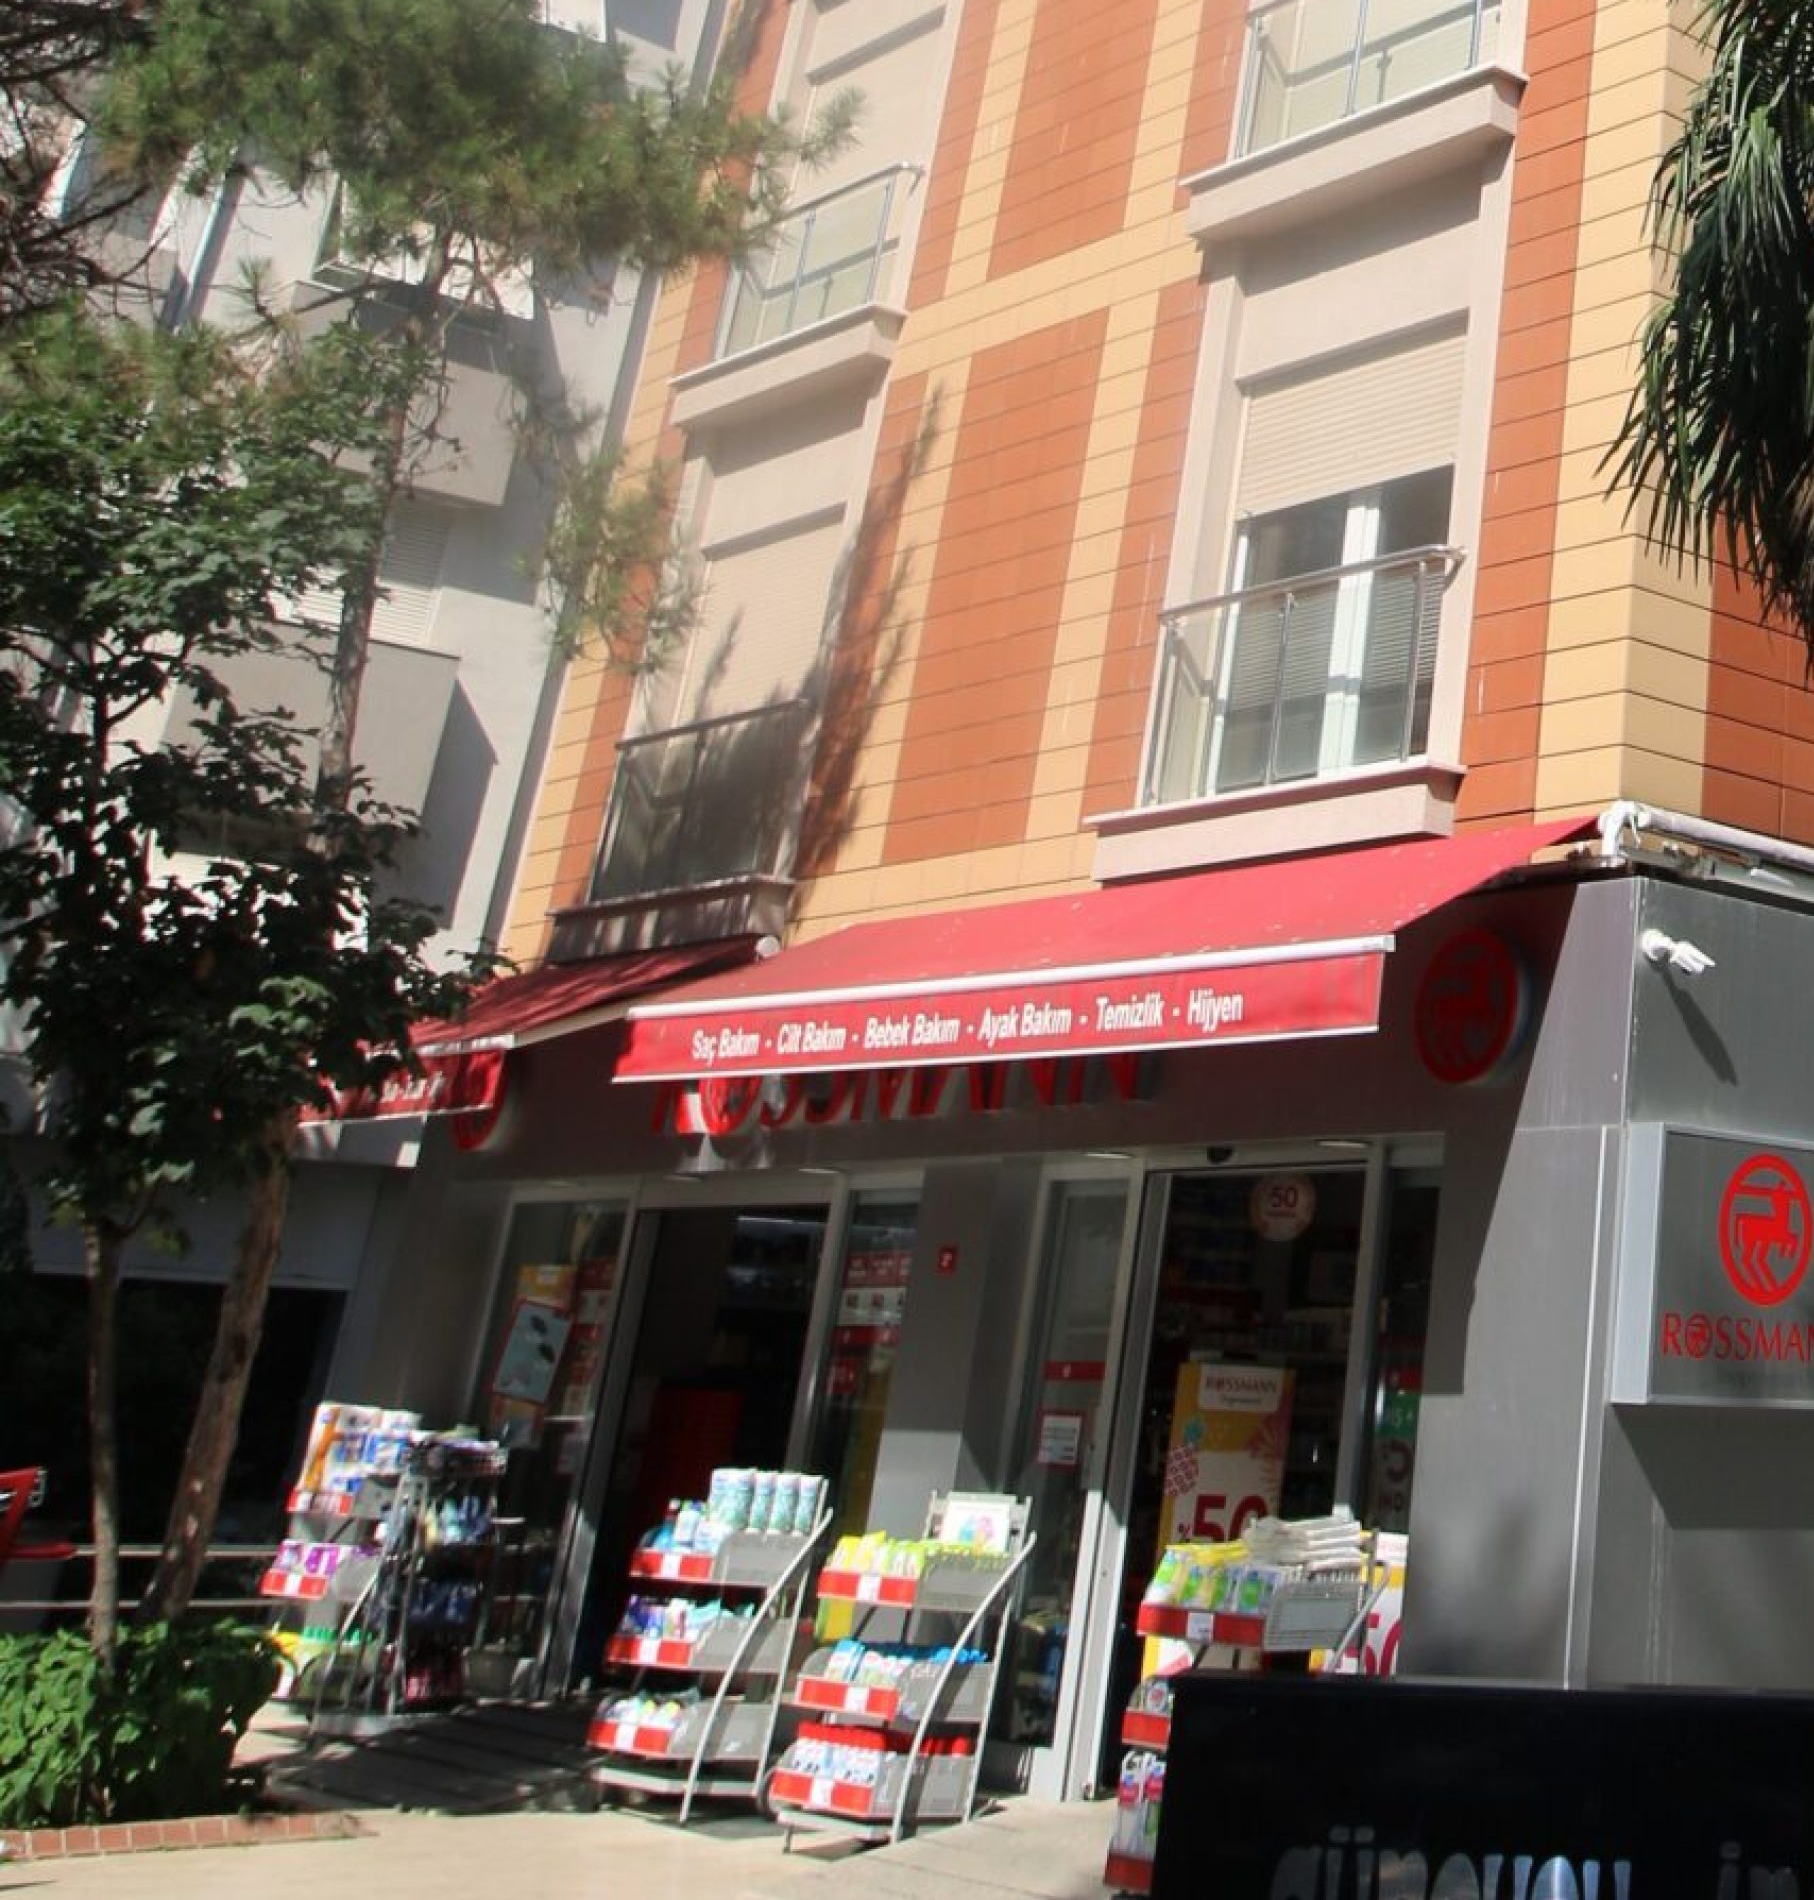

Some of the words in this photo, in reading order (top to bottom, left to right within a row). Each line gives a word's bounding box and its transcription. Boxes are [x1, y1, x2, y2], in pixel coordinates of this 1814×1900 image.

[692, 1027, 716, 1065] Saç
[718, 1026, 760, 1058] Bakım
[778, 1021, 802, 1055] Cilt
[803, 1019, 847, 1052] Bakım
[863, 1014, 910, 1049] Bebek
[911, 1012, 960, 1046] Bakım
[977, 1004, 1019, 1048] Ayak
[1020, 1002, 1072, 1037] Bakım
[1096, 990, 1164, 1031] Temizlik
[1187, 988, 1244, 1032] Hijyen
